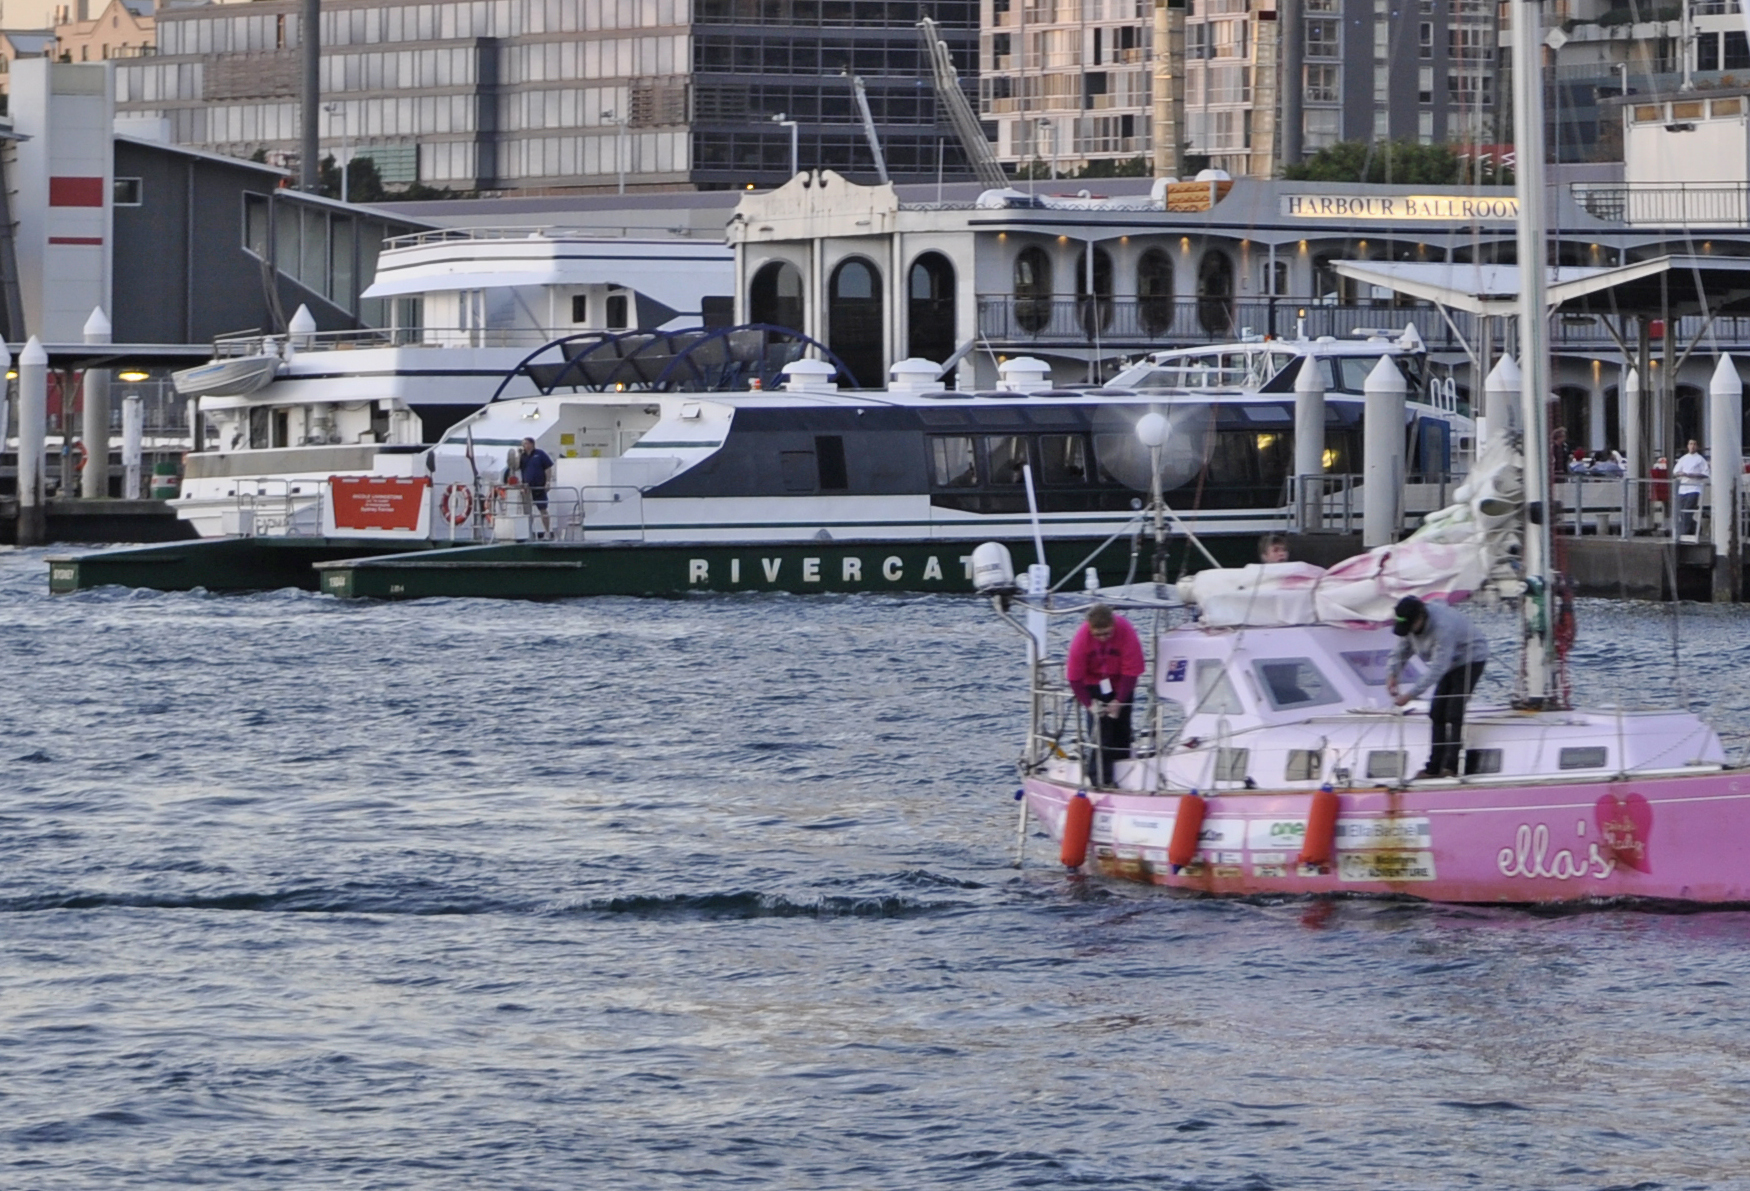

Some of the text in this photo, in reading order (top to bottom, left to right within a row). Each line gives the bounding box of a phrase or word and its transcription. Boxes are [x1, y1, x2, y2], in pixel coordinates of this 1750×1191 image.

[1288, 196, 1395, 216] HARBOUR
[689, 555, 974, 584] RIVERCAT
[1270, 822, 1305, 837] one
[1496, 820, 1616, 880] ella's
